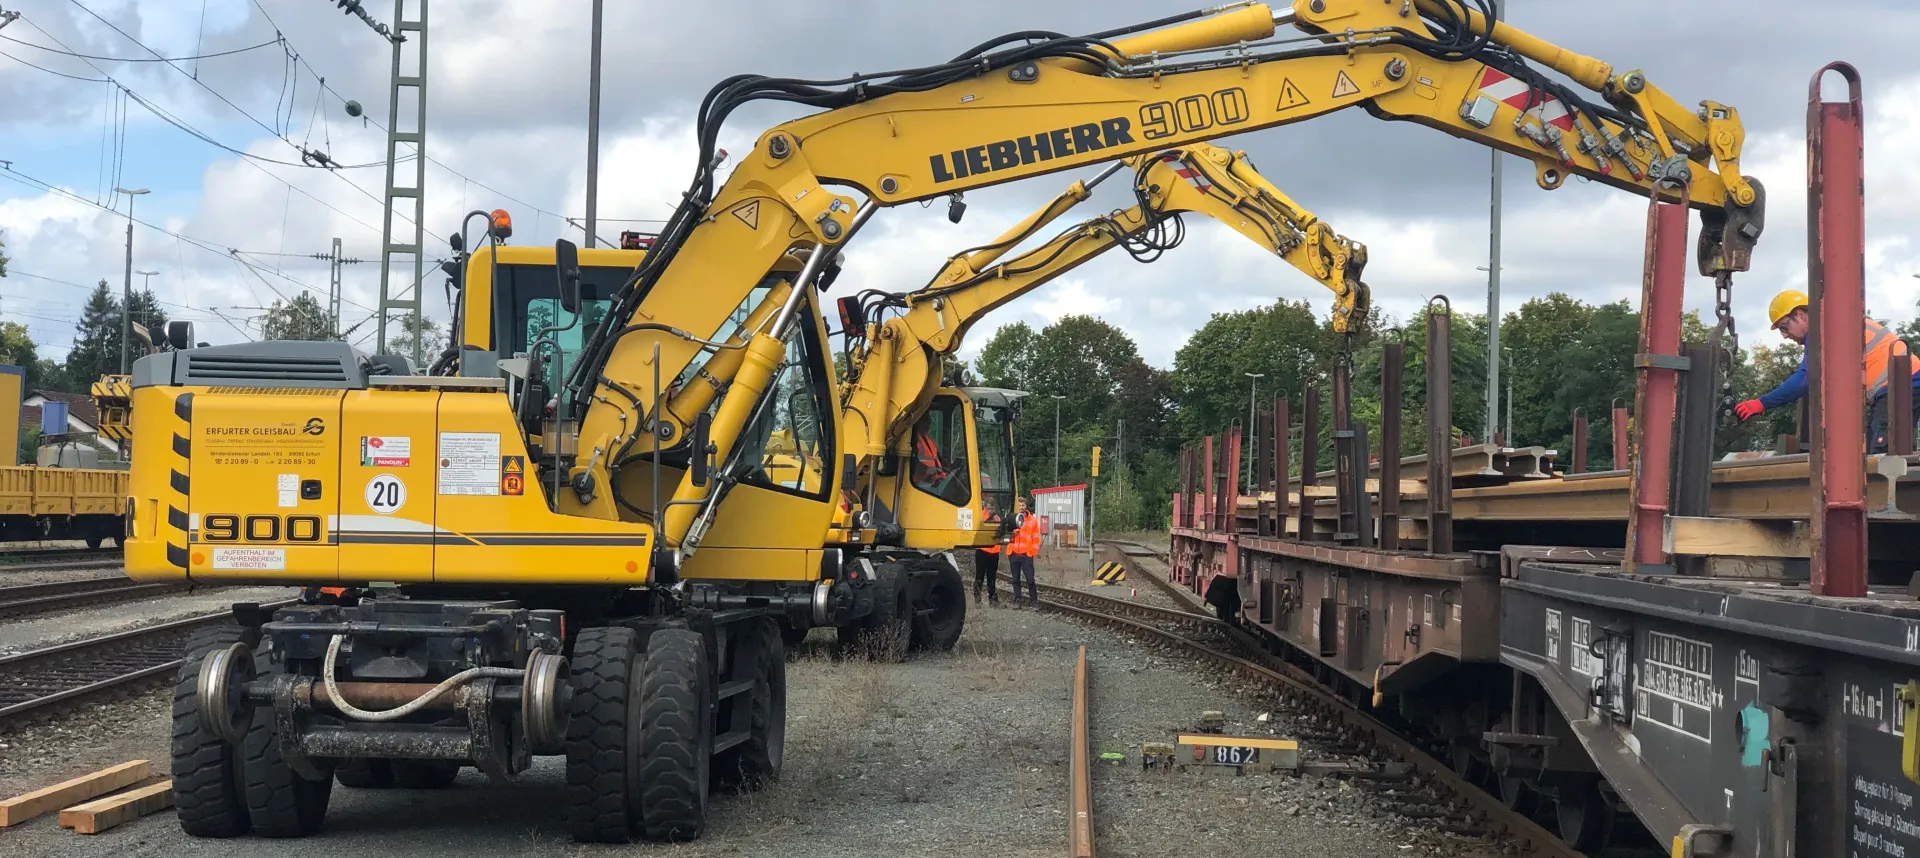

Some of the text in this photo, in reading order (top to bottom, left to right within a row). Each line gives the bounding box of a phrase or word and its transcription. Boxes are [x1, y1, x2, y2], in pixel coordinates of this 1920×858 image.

[930, 87, 1249, 183] LIEBHERR 900
[373, 481, 399, 507] 20
[203, 513, 322, 542] 900
[1217, 746, 1254, 763] 862
